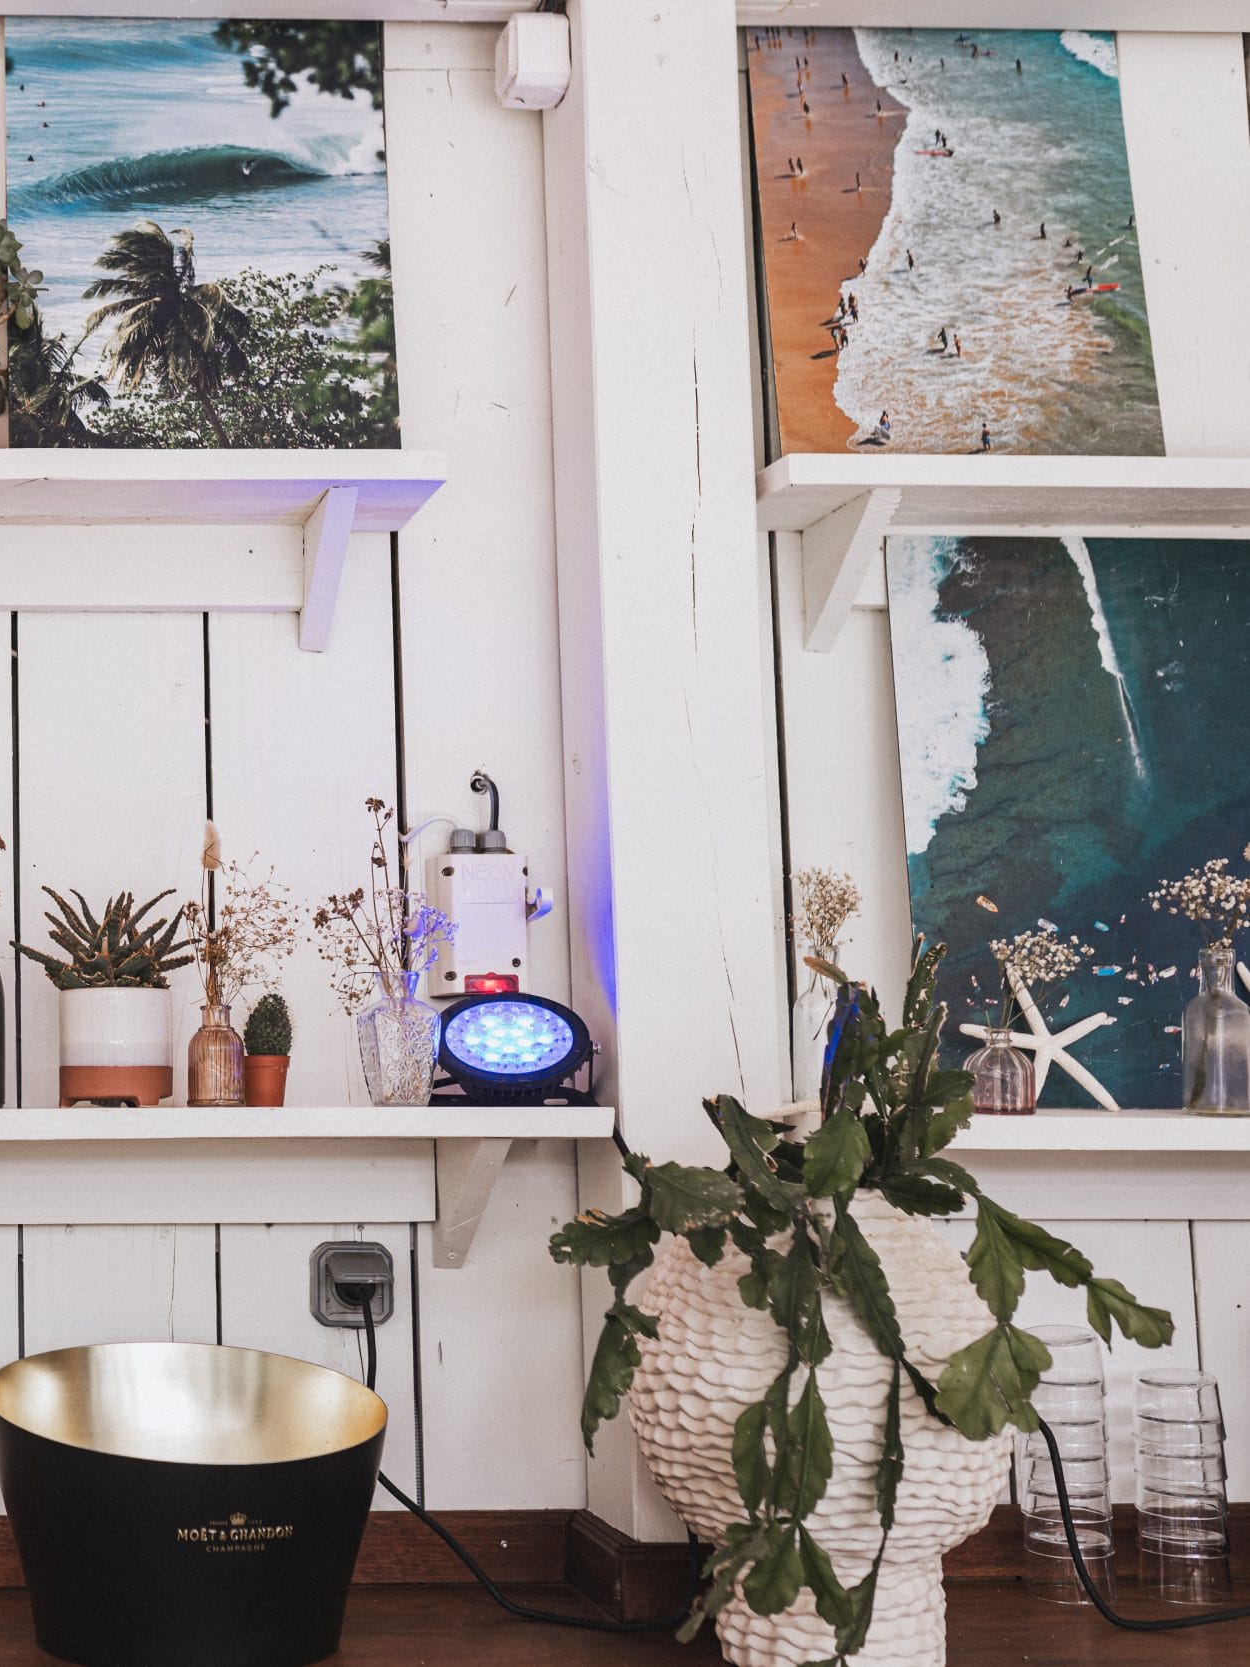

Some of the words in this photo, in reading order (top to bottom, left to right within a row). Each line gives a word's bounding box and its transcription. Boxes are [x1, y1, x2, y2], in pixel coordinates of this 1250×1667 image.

[461, 863, 515, 880] NEON
[230, 1525, 294, 1540] CHANDON
[205, 1543, 267, 1553] CHAMPAGNE
